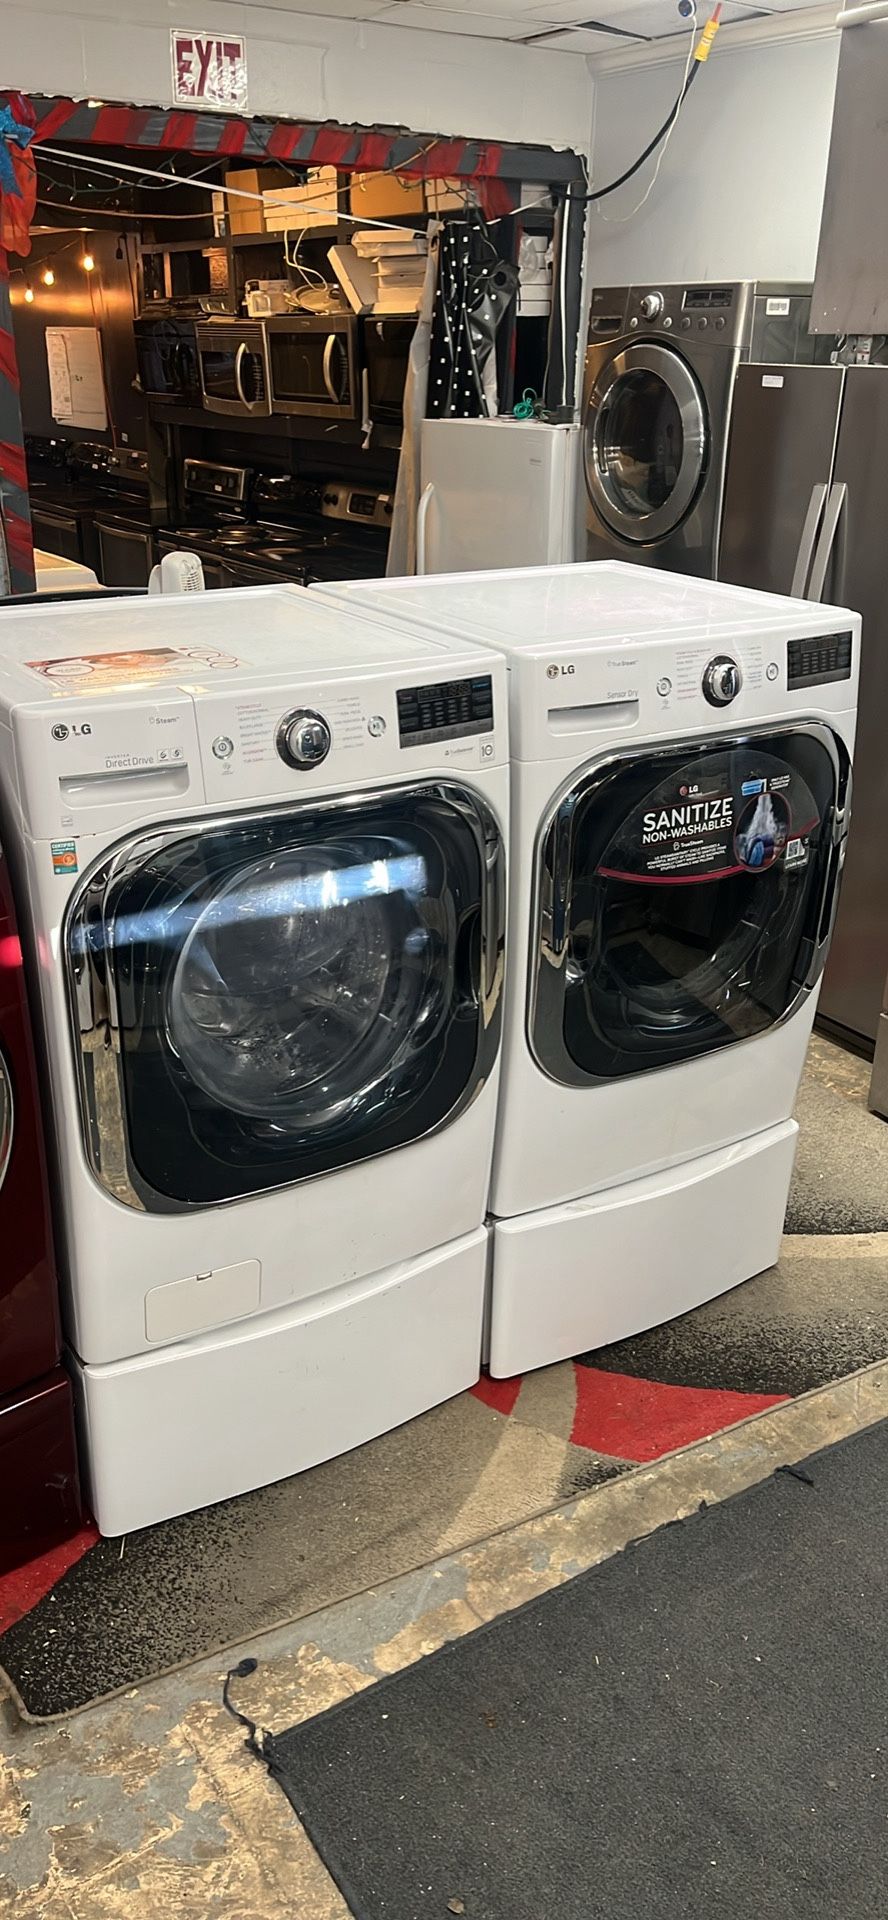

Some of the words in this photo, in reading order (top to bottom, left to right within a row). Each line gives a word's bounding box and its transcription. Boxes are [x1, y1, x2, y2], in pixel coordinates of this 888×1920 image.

[176, 40, 241, 99] EXIT
[561, 664, 575, 675] LG
[607, 691, 626, 699] Sensor
[628, 689, 638, 699] Dry
[105, 758, 132, 768] Direct
[132, 756, 154, 766] Drive
[688, 785, 699, 793] LG
[643, 797, 733, 832] SANITIZE
[642, 816, 733, 844] NON-WASHABLES
